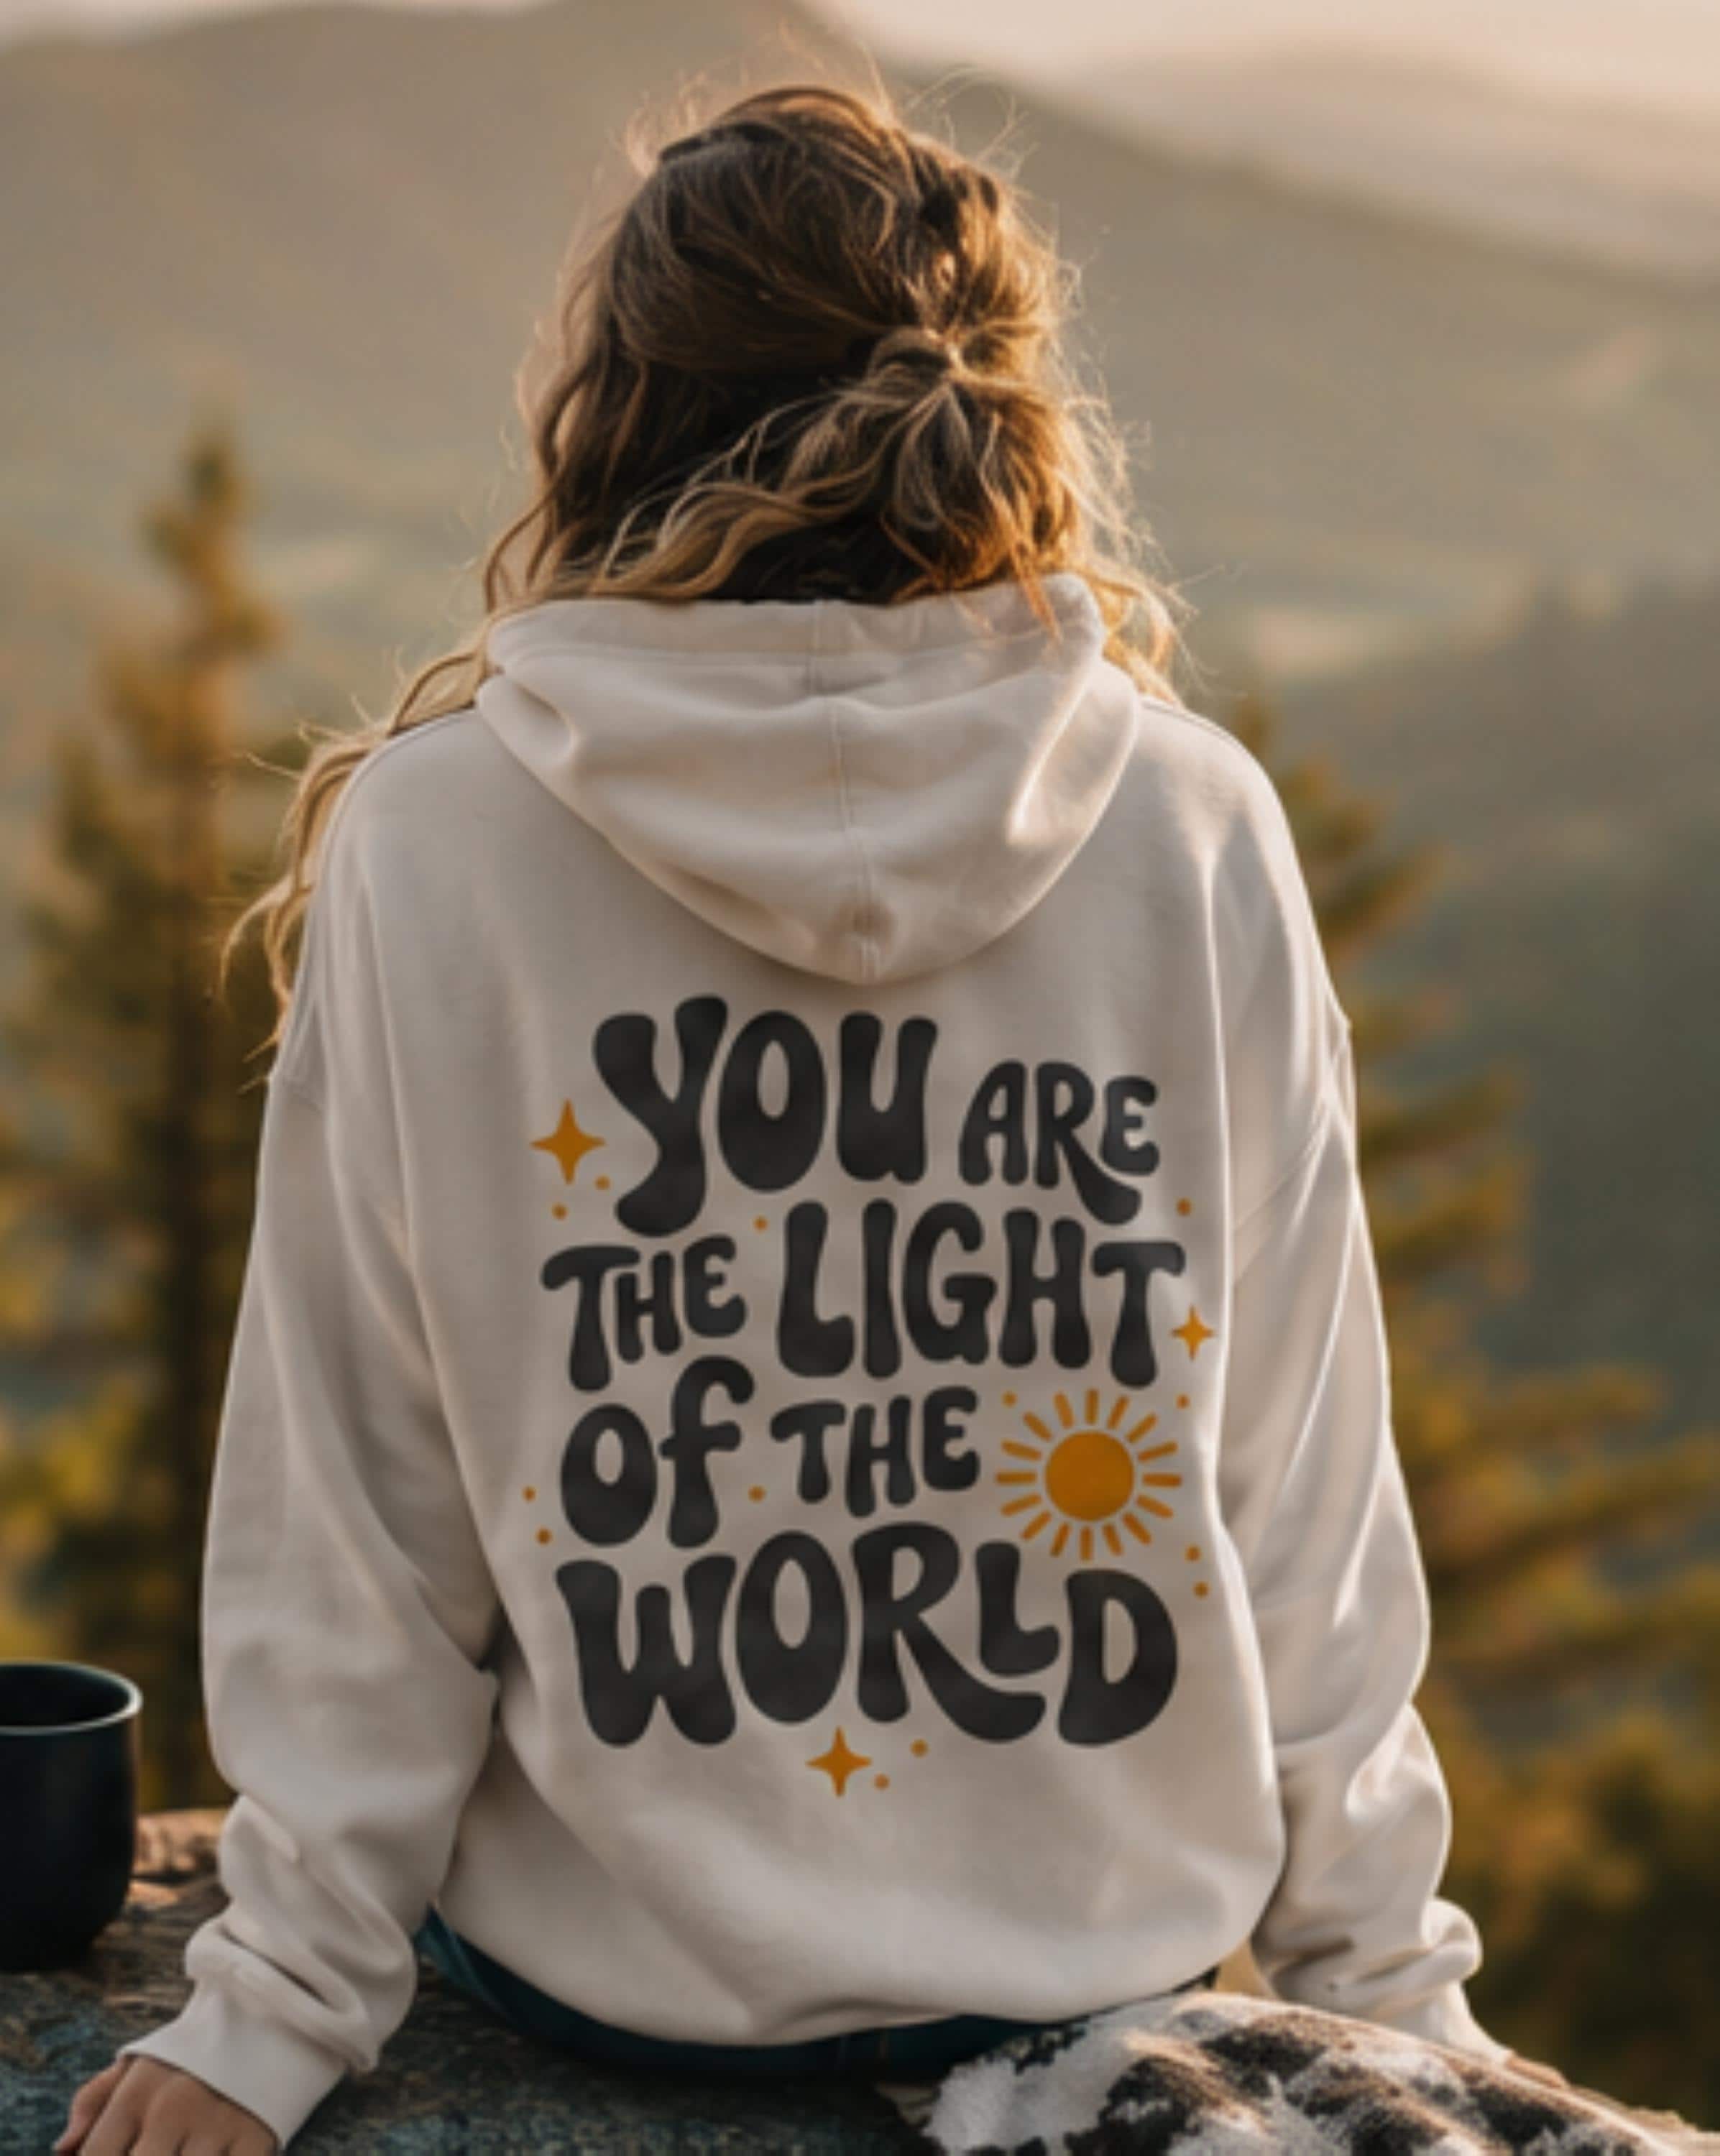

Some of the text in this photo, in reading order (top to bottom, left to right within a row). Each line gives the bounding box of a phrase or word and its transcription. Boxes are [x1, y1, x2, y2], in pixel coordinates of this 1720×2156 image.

[591, 995, 1161, 1239] YOU ARE
[540, 1197, 1186, 1394] THE LIGHT
[768, 1385, 981, 1519] THE
[554, 1520, 1179, 1749] WORLD
